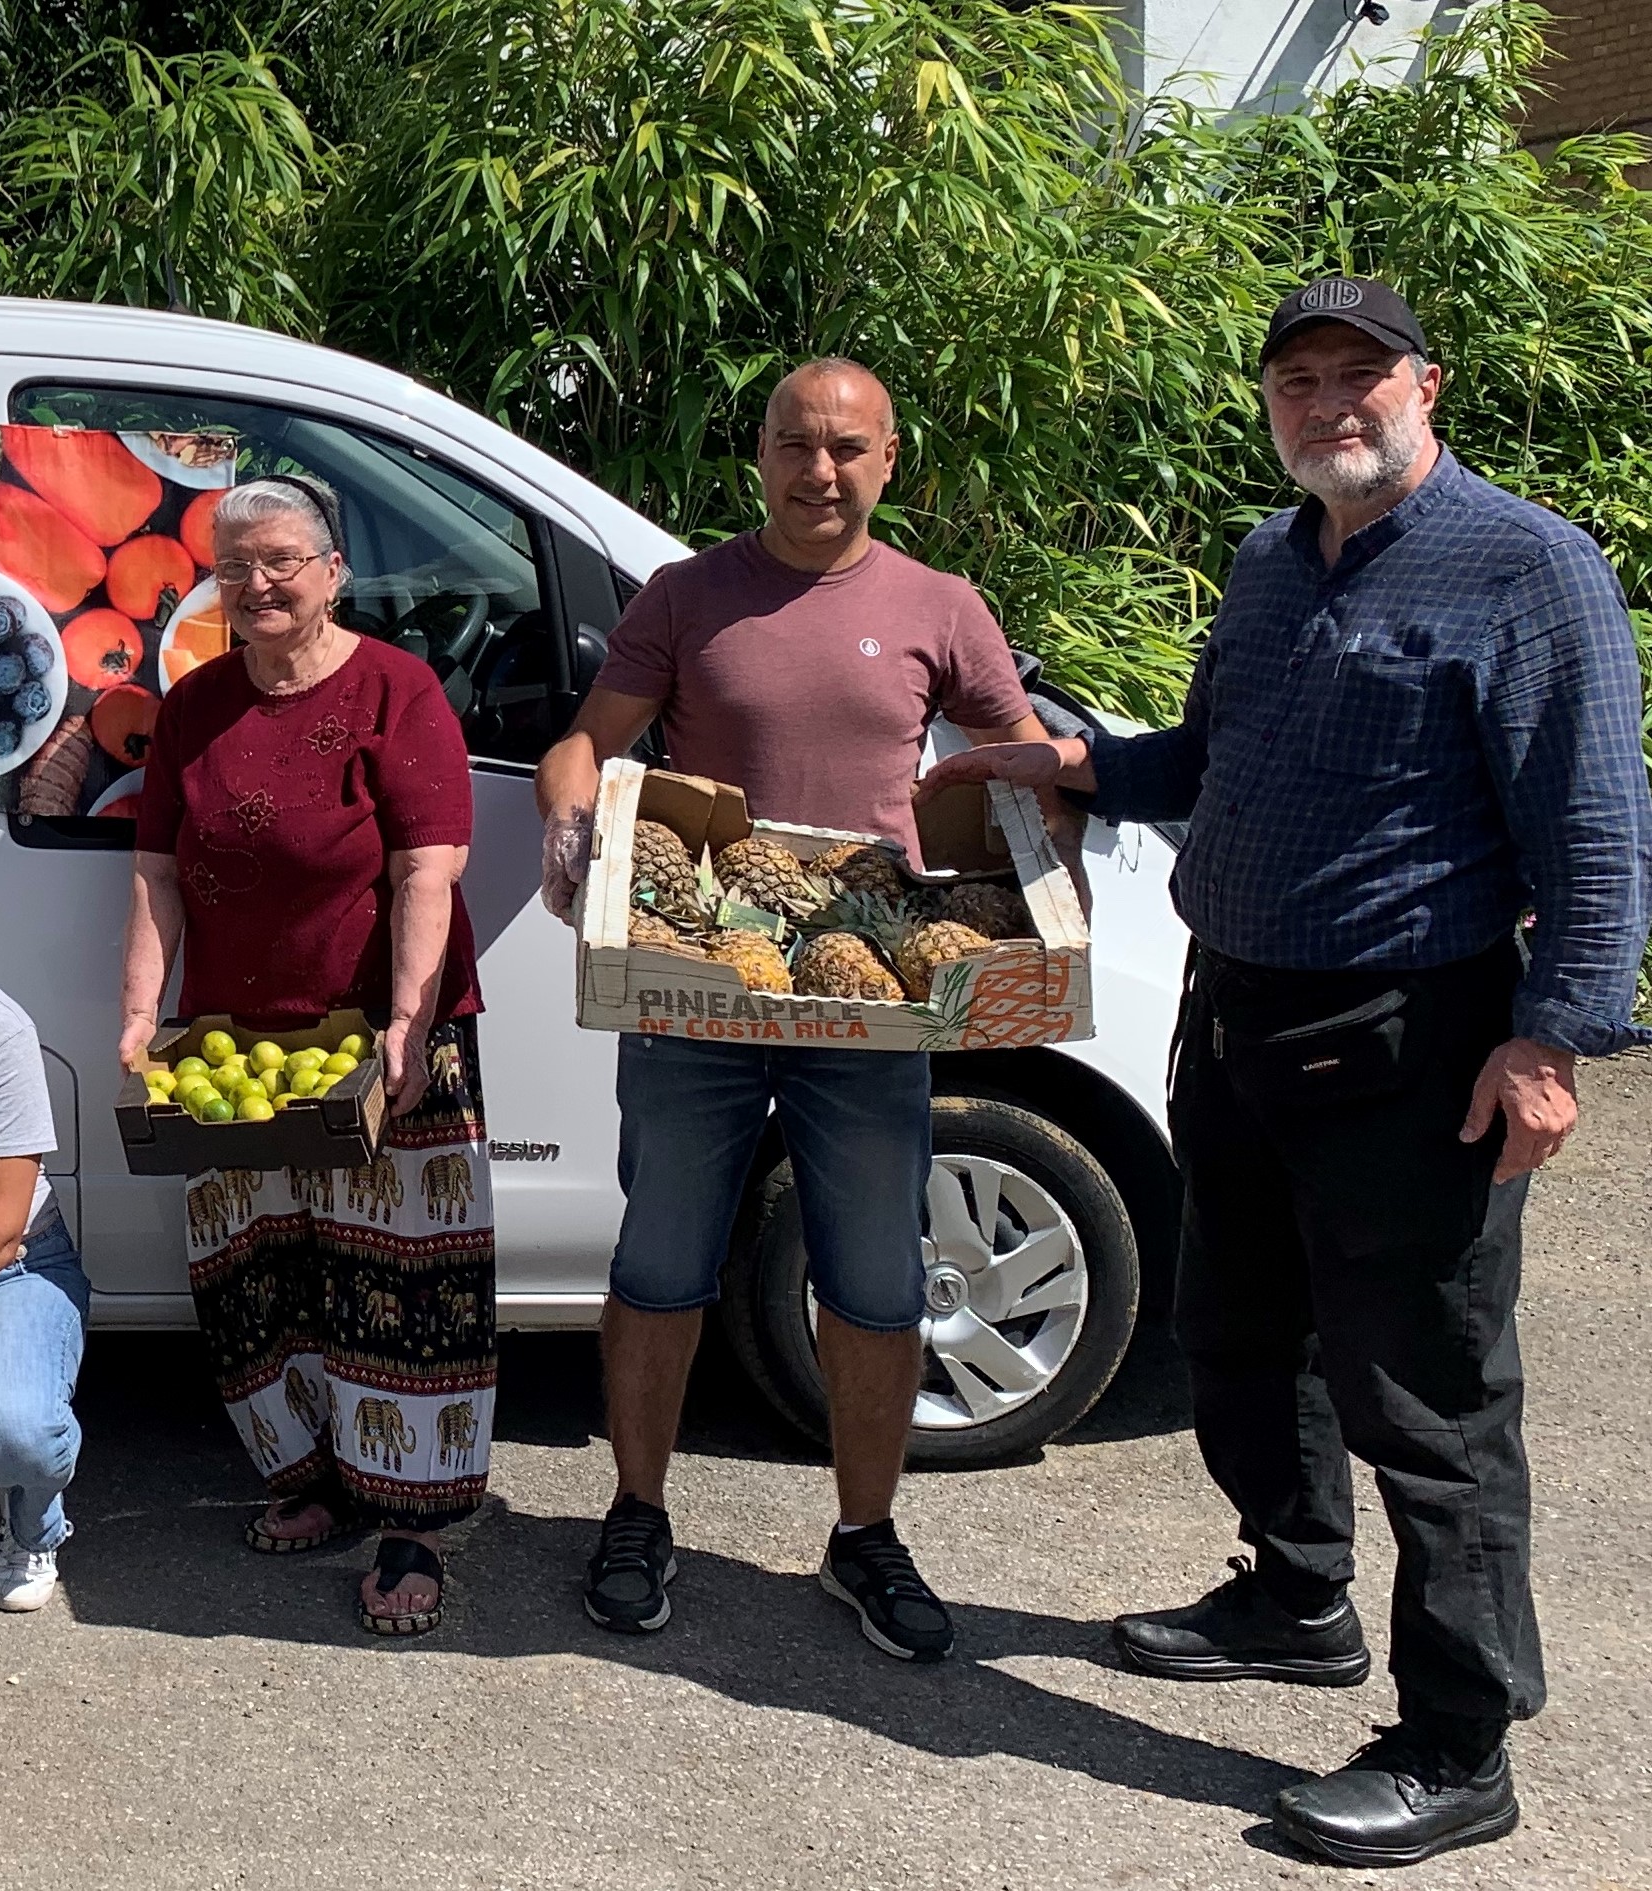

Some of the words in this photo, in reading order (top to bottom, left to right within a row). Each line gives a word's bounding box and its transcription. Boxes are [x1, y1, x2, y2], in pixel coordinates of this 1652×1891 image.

[638, 989, 863, 1021] PINEAPPLE
[637, 1018, 674, 1034] OF
[686, 1018, 784, 1040] COSTA
[795, 1020, 869, 1039] RICA
[488, 1138, 560, 1161] ission
